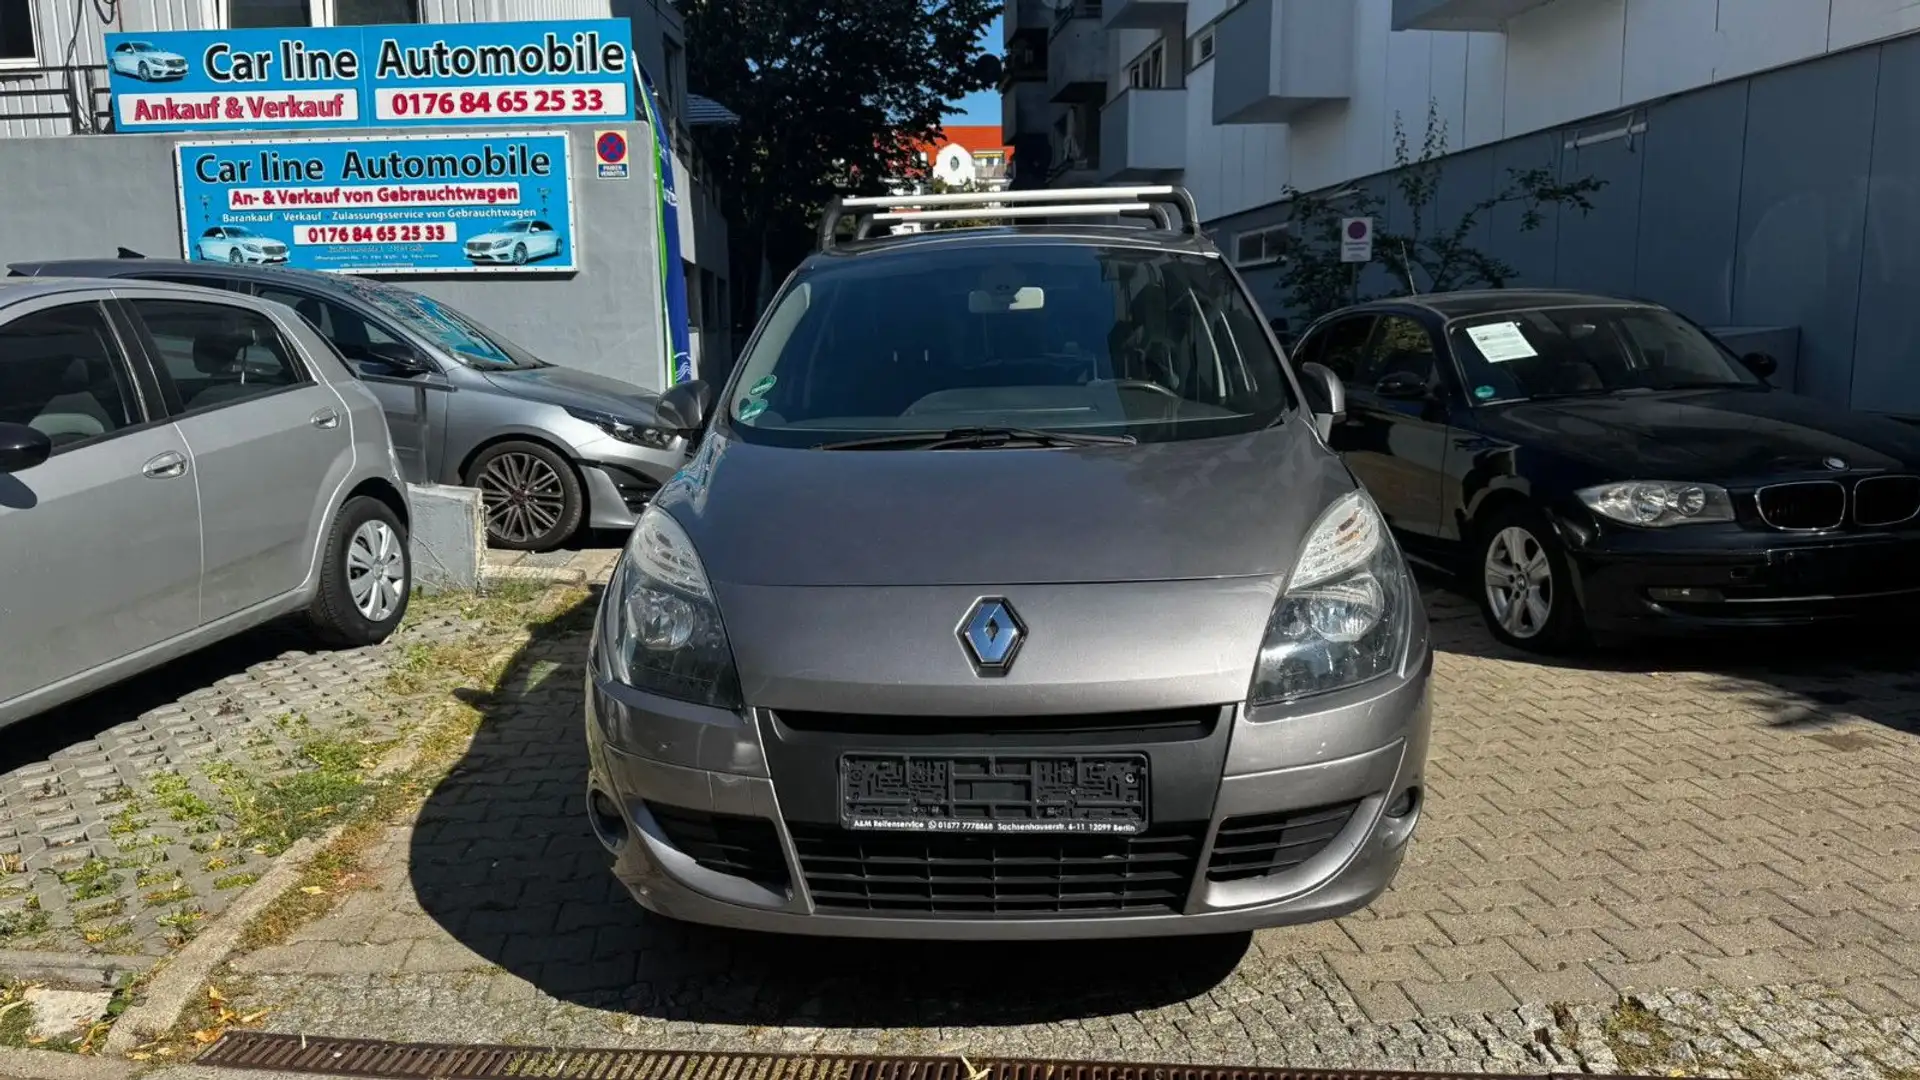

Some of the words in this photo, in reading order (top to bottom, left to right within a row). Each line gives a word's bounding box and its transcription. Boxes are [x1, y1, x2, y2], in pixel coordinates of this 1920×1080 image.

[203, 43, 272, 83] Car
[280, 40, 359, 81] line
[375, 31, 625, 78] Automobile
[135, 97, 220, 121] Ankauf
[225, 97, 244, 118] &
[246, 94, 344, 119] Verkauf
[392, 92, 455, 115] 0176
[460, 91, 492, 113] 84
[497, 90, 528, 112] 65
[534, 89, 565, 111] 25
[571, 89, 604, 111] 33
[195, 153, 251, 184] Car
[259, 150, 324, 182] line
[341, 143, 550, 181] Automobile
[231, 190, 259, 206] An-
[263, 190, 275, 205] &
[277, 187, 340, 205] Verkauf
[343, 190, 373, 203] von
[377, 185, 518, 204] Gebrauchtwagen
[222, 213, 273, 223] Barankauf
[283, 211, 322, 221] Verkauf
[332, 209, 424, 221] Zulassungsservice
[426, 209, 445, 218] von
[447, 207, 537, 219] Gebrauchtwagen
[308, 227, 349, 243] 0176
[352, 226, 373, 242] 84
[377, 226, 397, 241] 65
[401, 225, 421, 240] 25
[425, 224, 445, 240] 33
[873, 820, 924, 829] Reifenservice
[1089, 822, 1112, 832] 12099
[1113, 823, 1136, 832] Berlin
